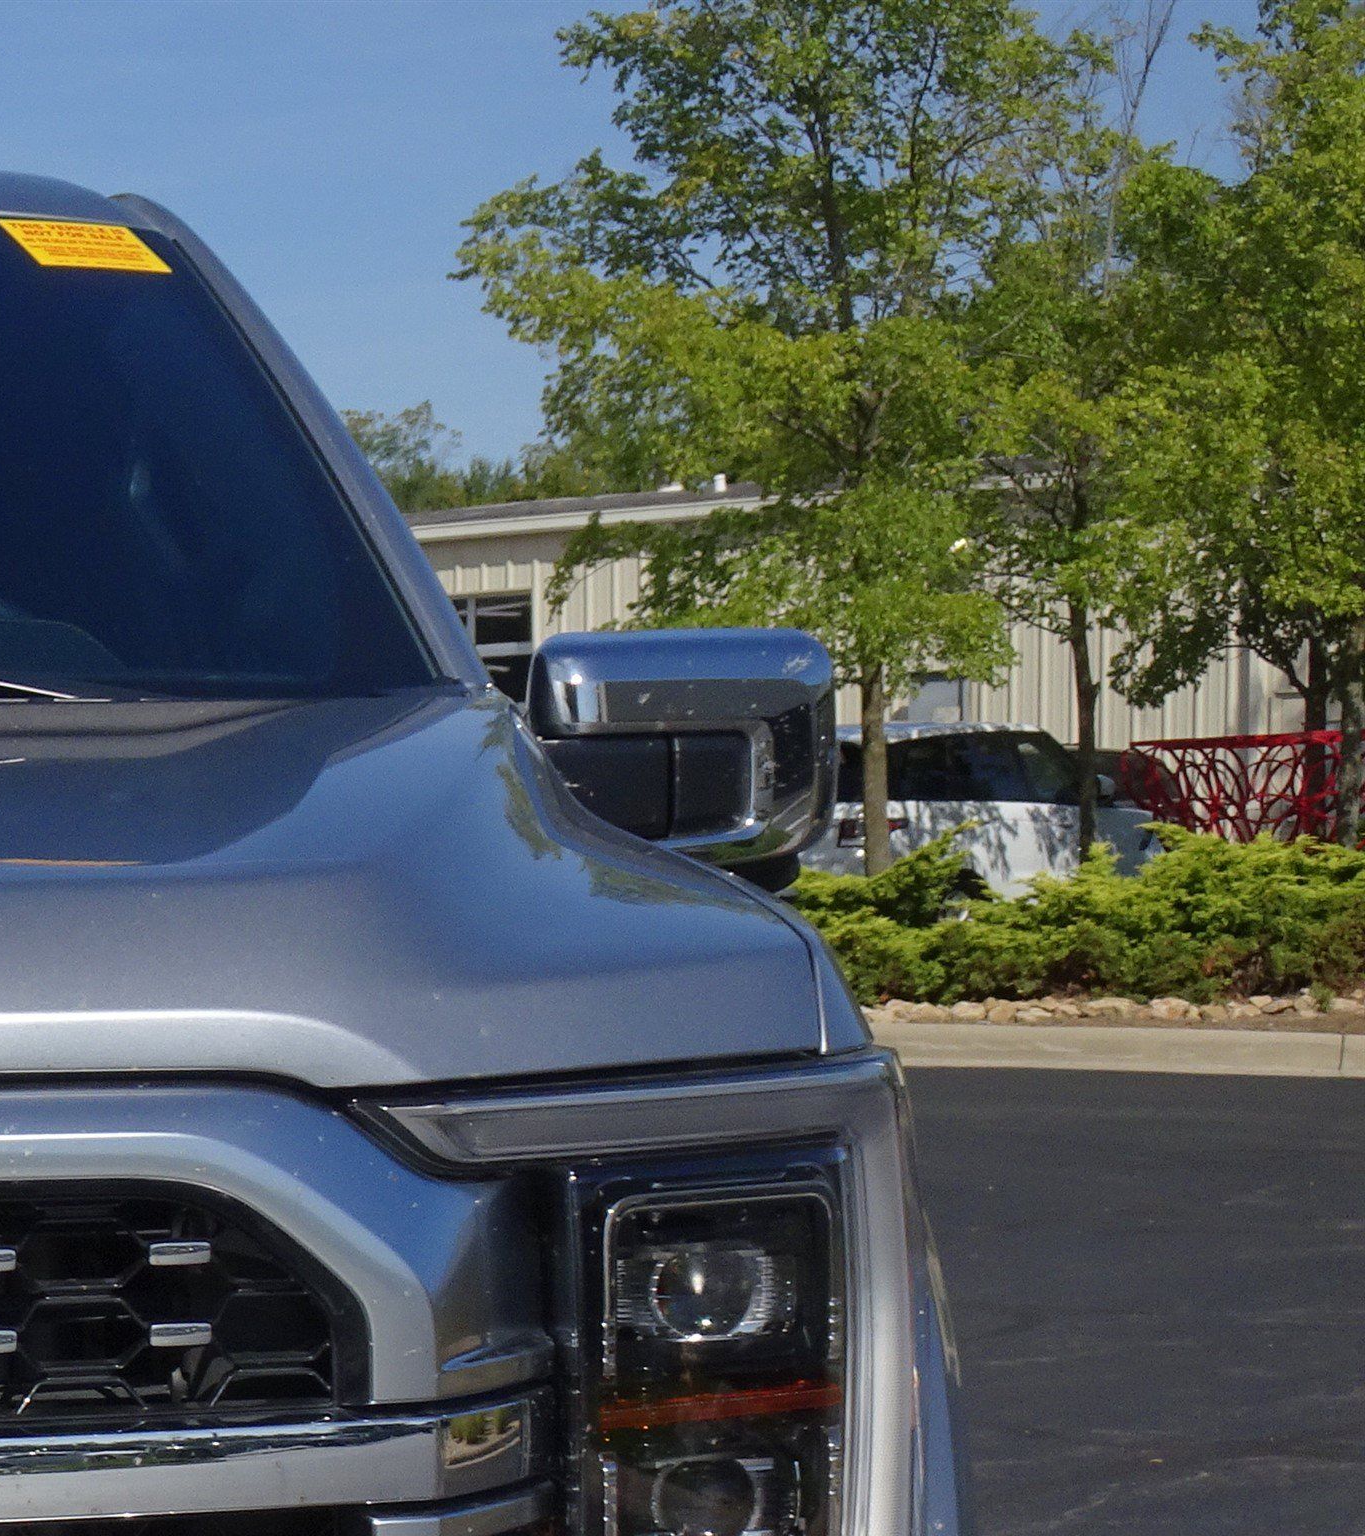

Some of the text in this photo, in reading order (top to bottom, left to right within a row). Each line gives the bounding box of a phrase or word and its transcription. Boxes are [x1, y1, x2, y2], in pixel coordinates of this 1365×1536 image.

[46, 224, 106, 233] VEHICLE
[22, 229, 125, 241] NOT FOR SALE
